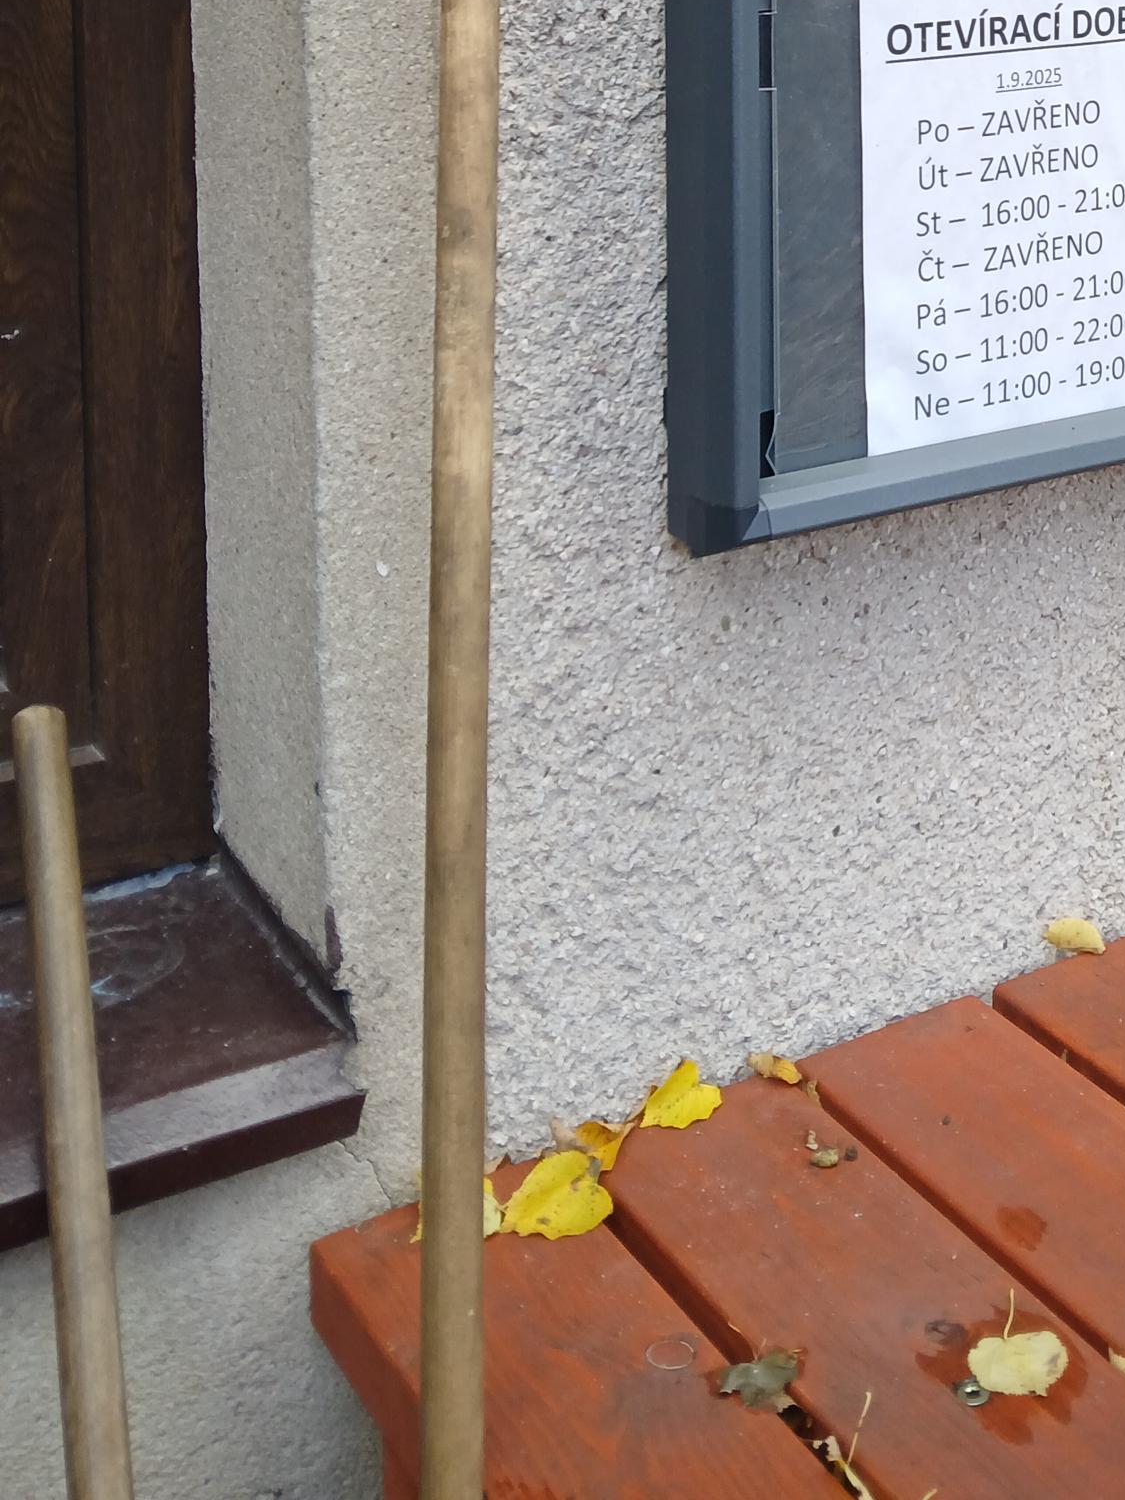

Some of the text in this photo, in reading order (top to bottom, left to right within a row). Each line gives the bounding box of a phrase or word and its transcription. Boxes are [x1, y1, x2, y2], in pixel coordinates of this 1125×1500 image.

[887, 3, 1063, 55] OTEVÍRACÍ
[996, 68, 1062, 89] 1.9.2025
[918, 119, 949, 144] Po
[981, 99, 1100, 137] ZAVŘENO
[918, 157, 949, 190] Út
[980, 143, 1098, 182] ZAVŘENO
[916, 211, 941, 236] St
[981, 195, 1050, 227] 16:00
[918, 249, 944, 281] Čt
[984, 231, 1103, 272] ZAVŘENO
[917, 299, 946, 329] Pá
[980, 284, 1048, 318] 16:00
[916, 350, 947, 375] So
[980, 328, 1048, 363] 11:00
[914, 394, 950, 420] Ne
[983, 371, 1051, 406] 11:00
